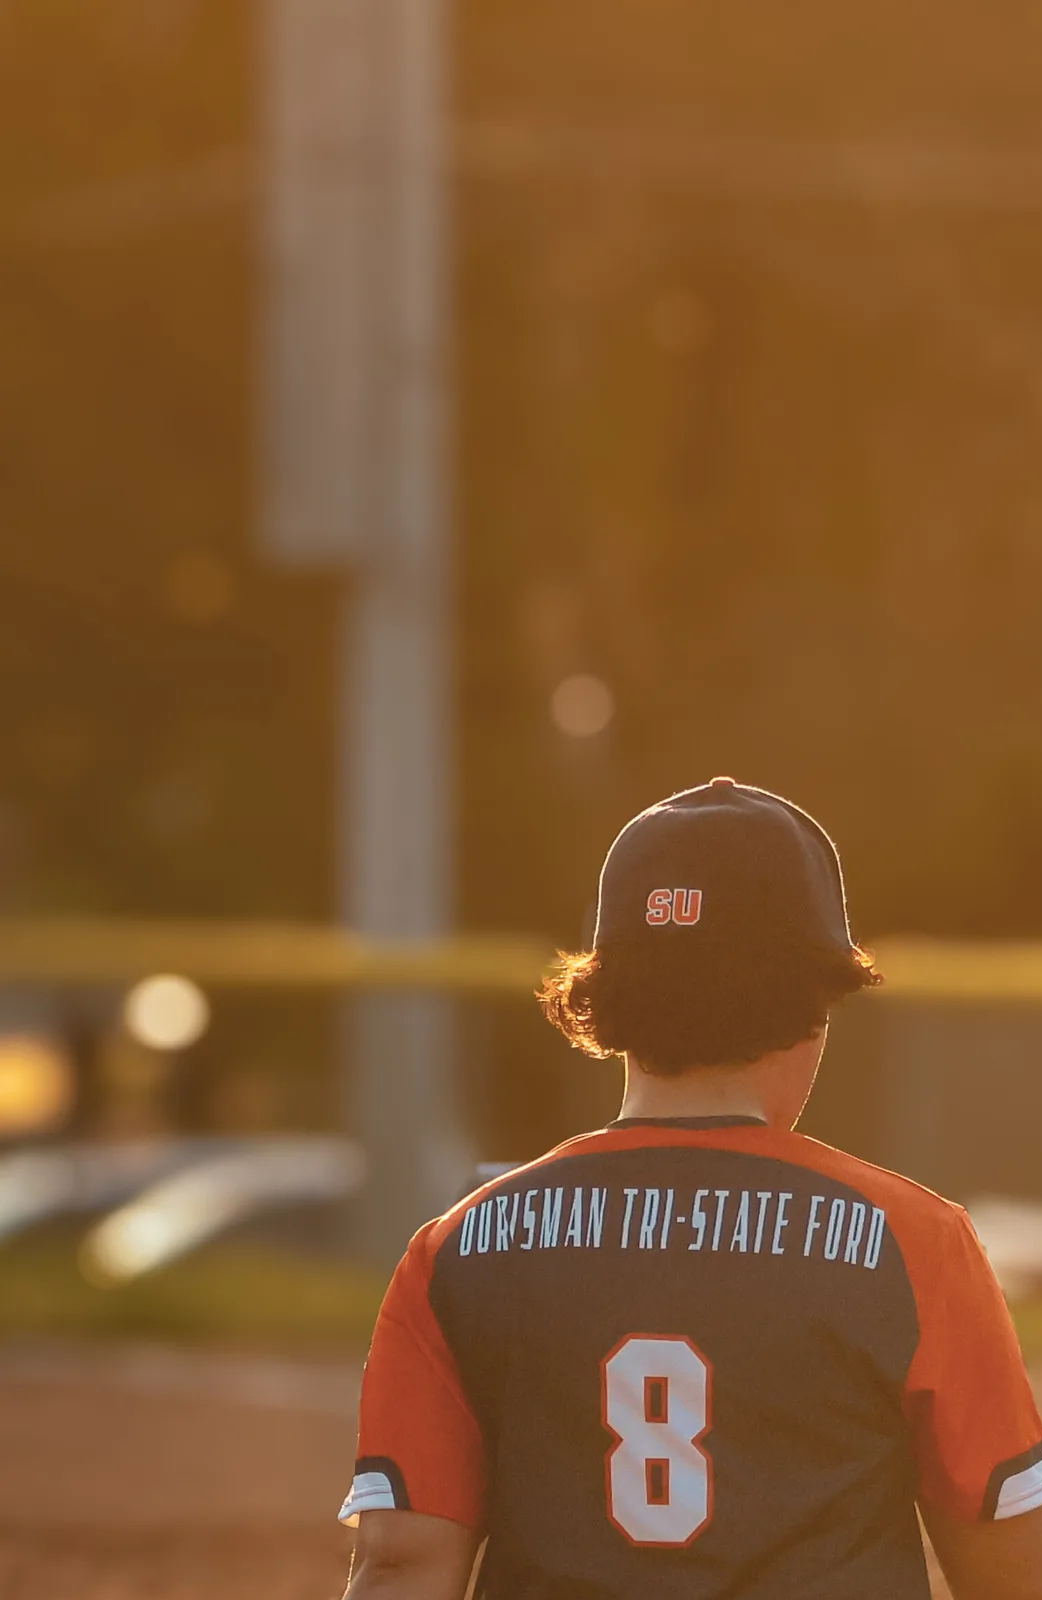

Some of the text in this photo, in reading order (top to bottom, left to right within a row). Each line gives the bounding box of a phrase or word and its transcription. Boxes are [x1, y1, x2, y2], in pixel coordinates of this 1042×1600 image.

[646, 888, 702, 925] SU
[459, 1187, 886, 1270] OURISMAN TRI-STATE FORD
[600, 1332, 714, 1548] 8
